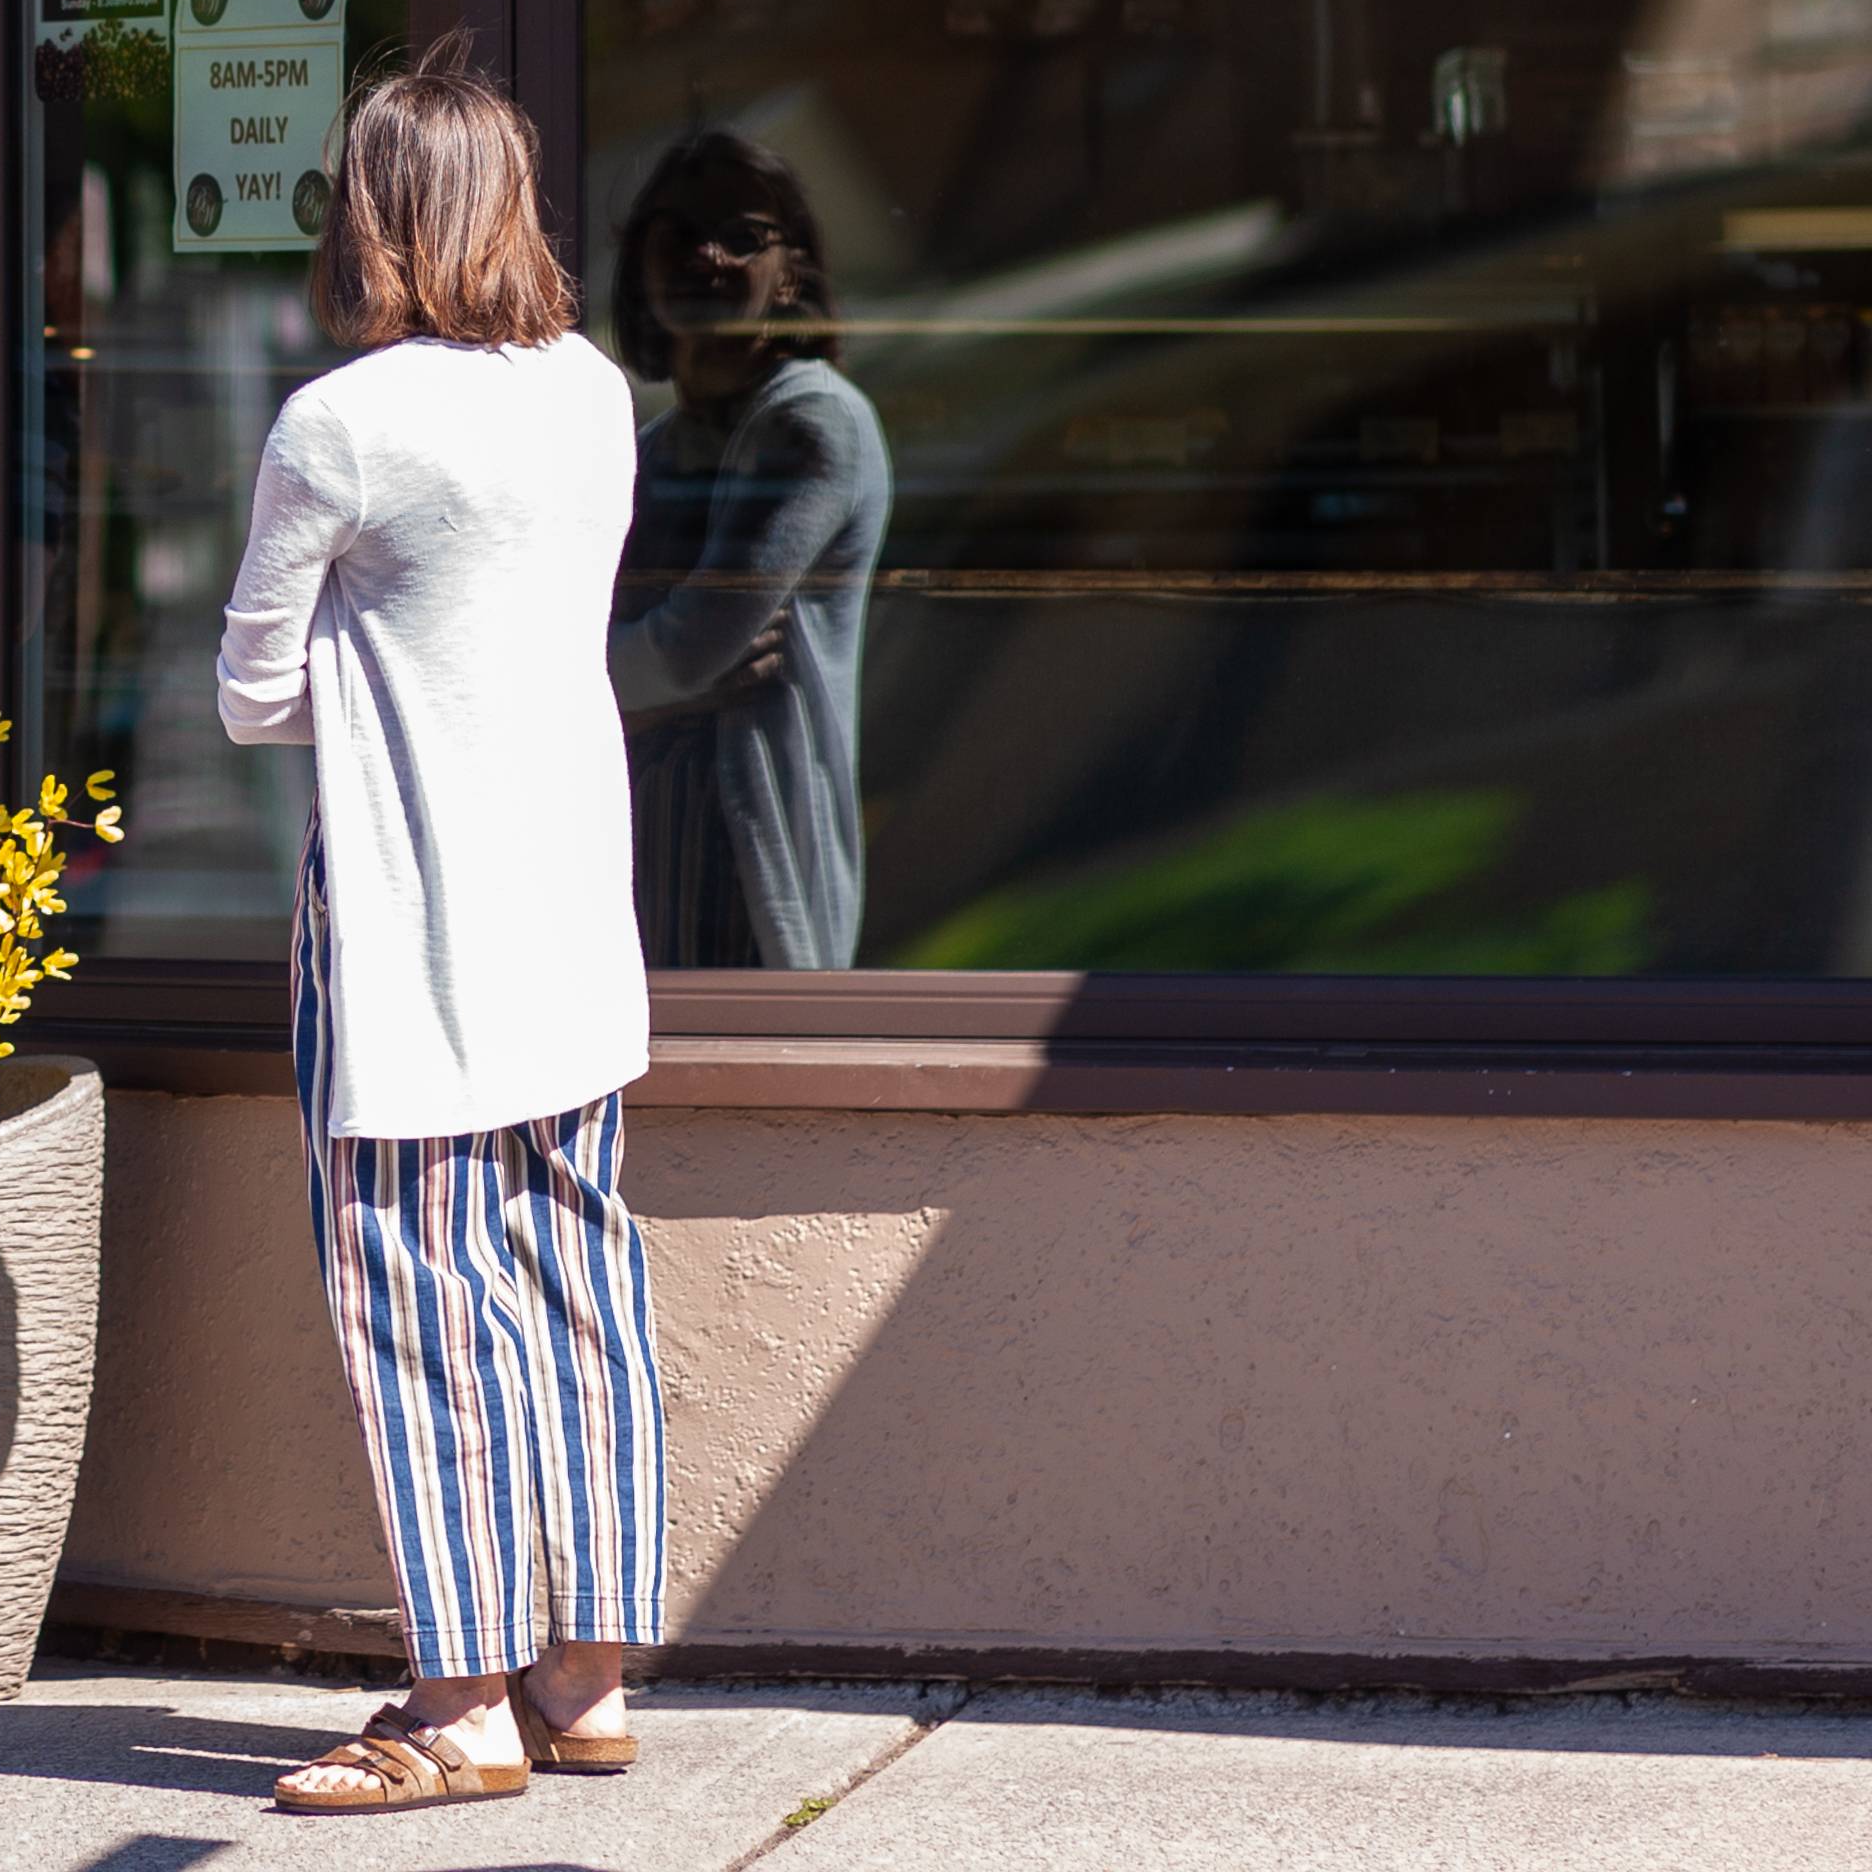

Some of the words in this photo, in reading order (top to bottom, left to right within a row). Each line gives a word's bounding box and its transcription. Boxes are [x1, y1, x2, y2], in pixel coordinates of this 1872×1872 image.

[210, 59, 308, 89] 8AM-5PM
[230, 117, 288, 144] DAILY
[235, 172, 281, 201] YAY!
